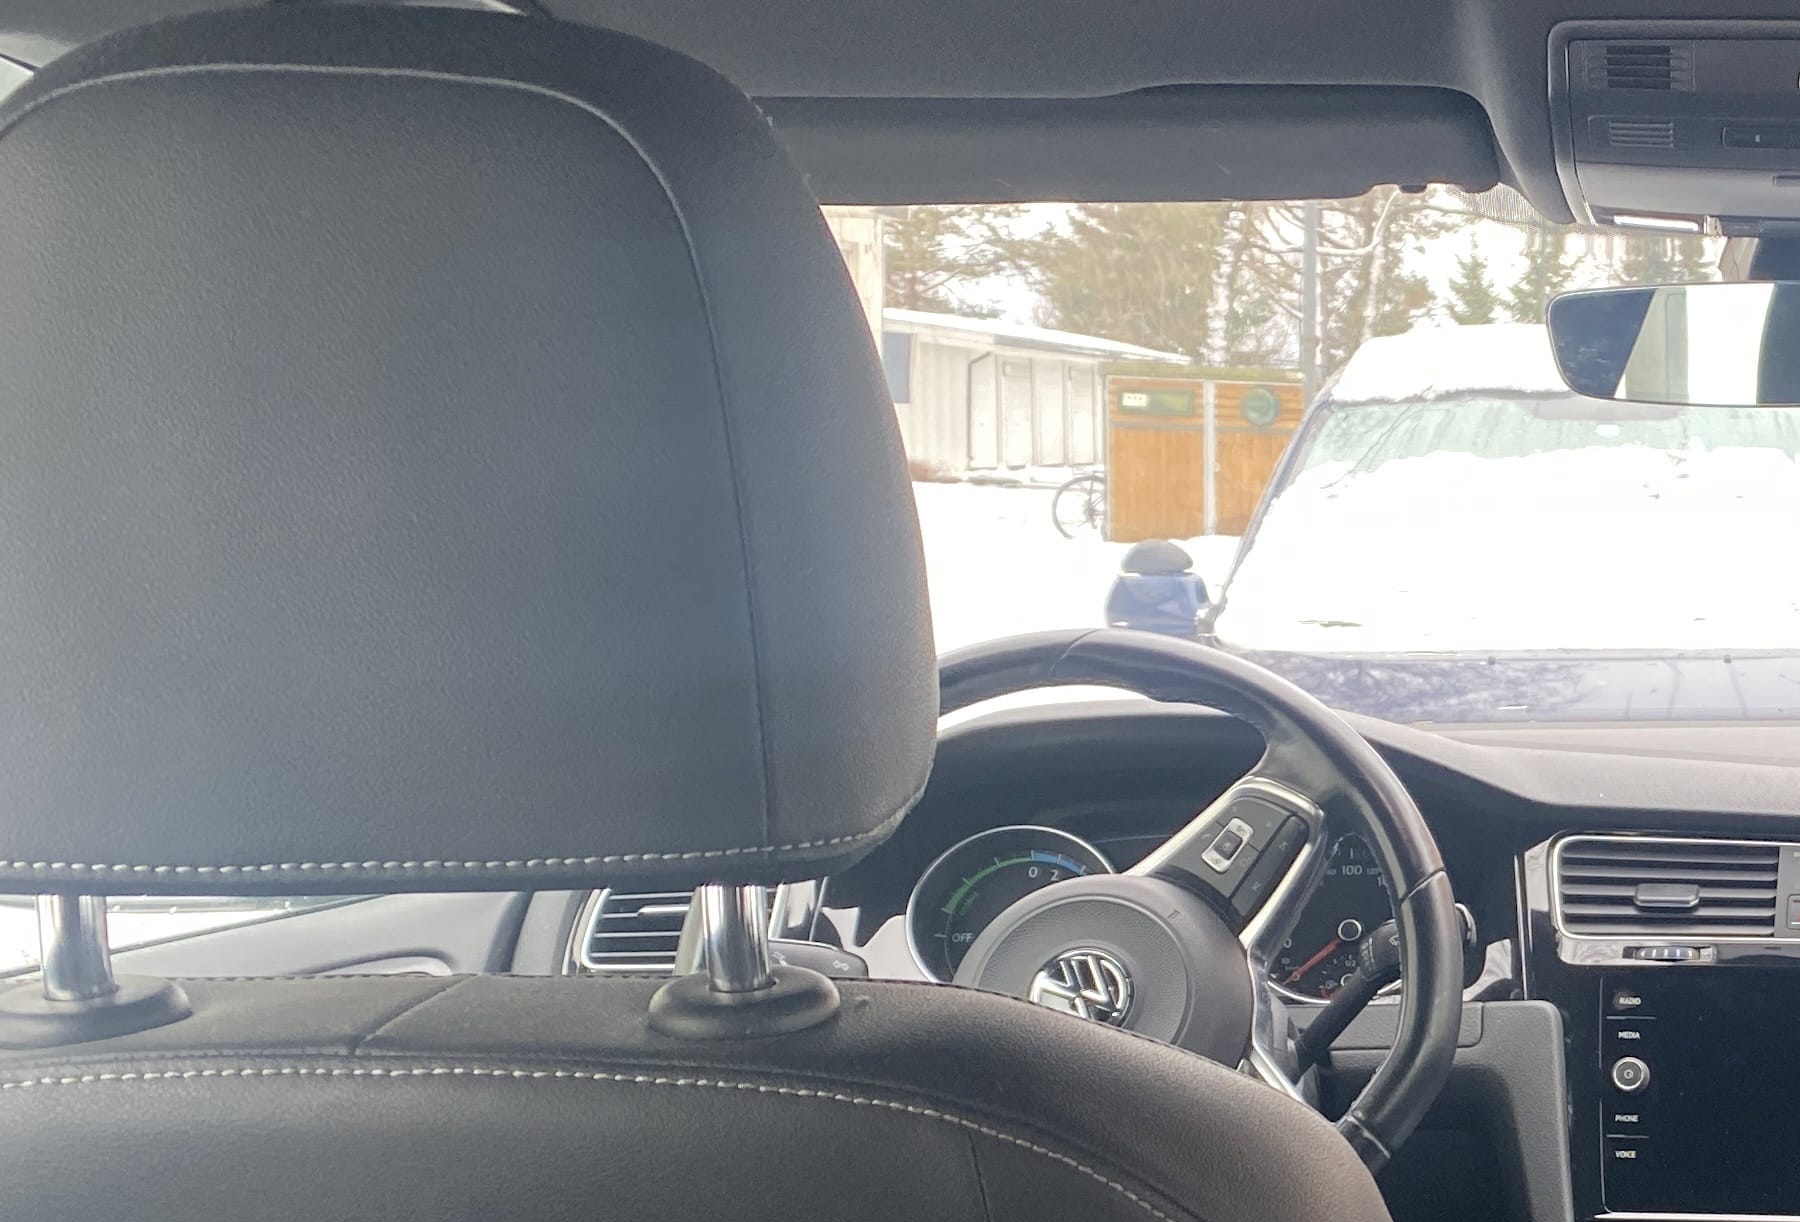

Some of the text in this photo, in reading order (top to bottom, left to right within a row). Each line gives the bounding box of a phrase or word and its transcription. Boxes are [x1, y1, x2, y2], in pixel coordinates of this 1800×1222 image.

[1341, 864, 1363, 876] 100
[951, 932, 974, 943] OFF
[1618, 996, 1642, 1006] RADIO
[1618, 1031, 1641, 1040] MEDIA
[1615, 1114, 1639, 1123] PHONE
[1615, 1150, 1637, 1159] VOICE
